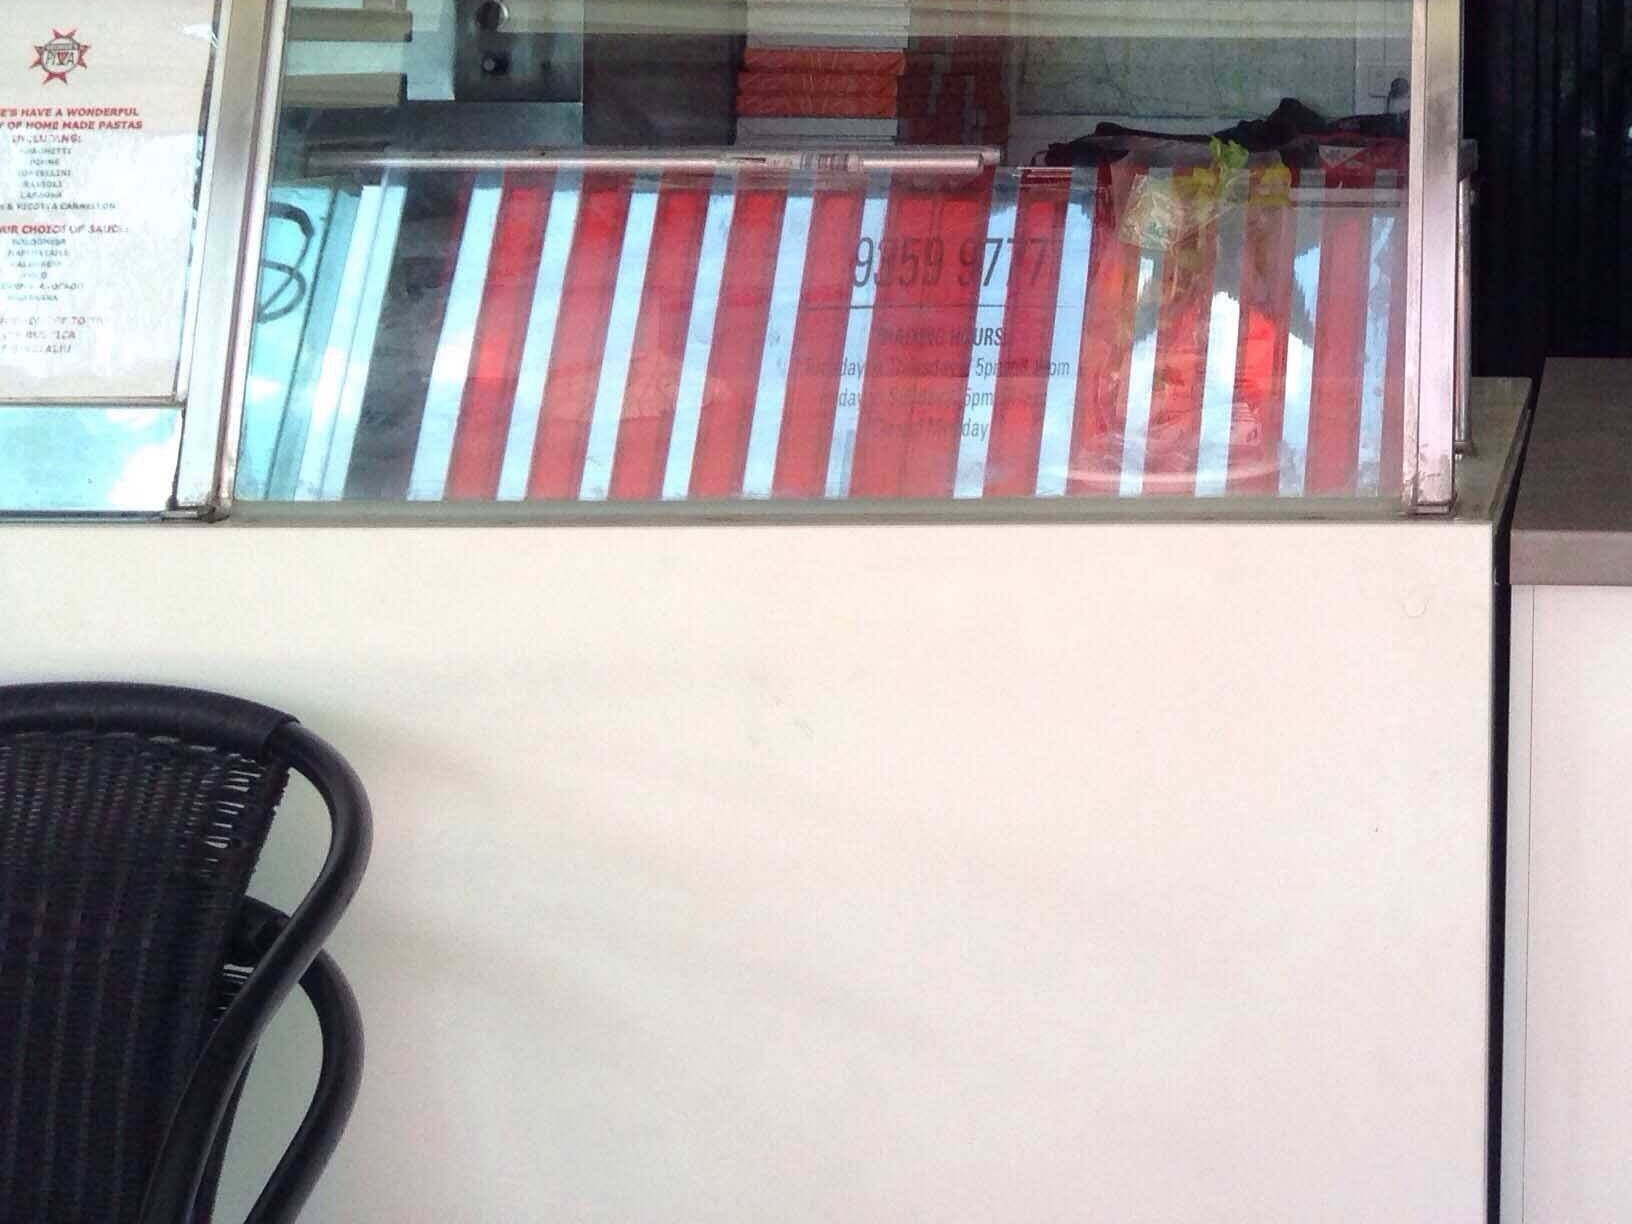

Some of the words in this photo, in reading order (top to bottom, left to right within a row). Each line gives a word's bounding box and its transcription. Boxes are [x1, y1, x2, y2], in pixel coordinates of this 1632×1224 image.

[20, 107, 53, 117] HAVE
[55, 108, 63, 117] A
[66, 107, 140, 117] WONDERFUL
[7, 121, 22, 130] OF
[25, 121, 59, 130] HOME
[62, 121, 95, 130] MADE
[98, 120, 144, 130] PASTAS
